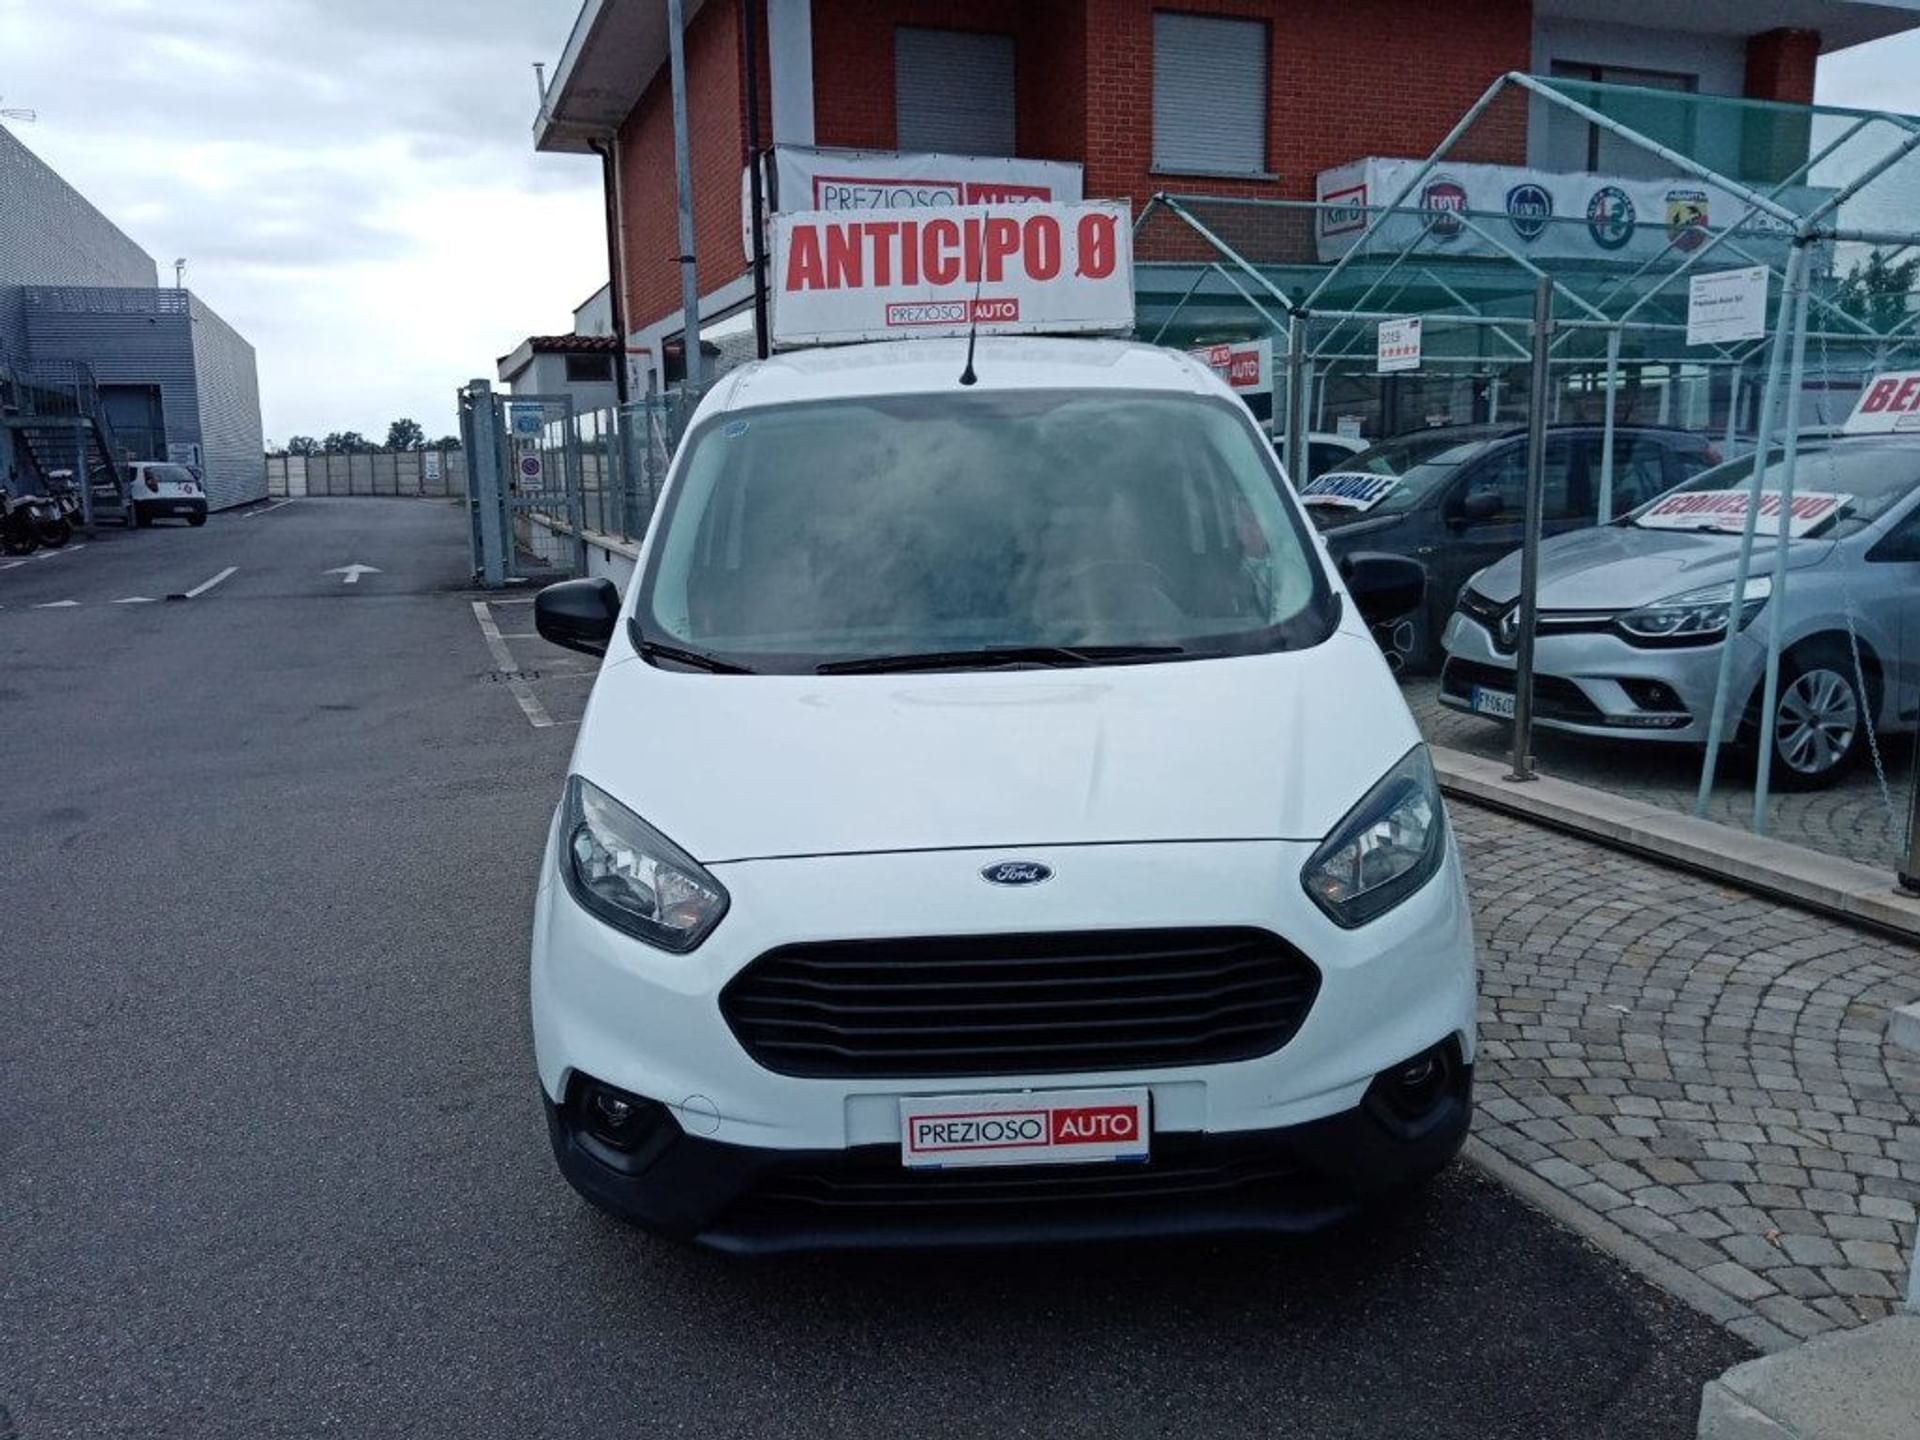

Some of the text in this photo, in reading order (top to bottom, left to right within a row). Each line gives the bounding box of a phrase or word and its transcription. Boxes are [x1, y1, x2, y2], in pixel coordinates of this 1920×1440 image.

[786, 214, 1062, 292] ANTICIPO
[892, 303, 1016, 321] PREZIOSO AUTO
[996, 864, 1038, 880] Ford
[918, 1114, 1132, 1143] PREZIOSO AUTO
